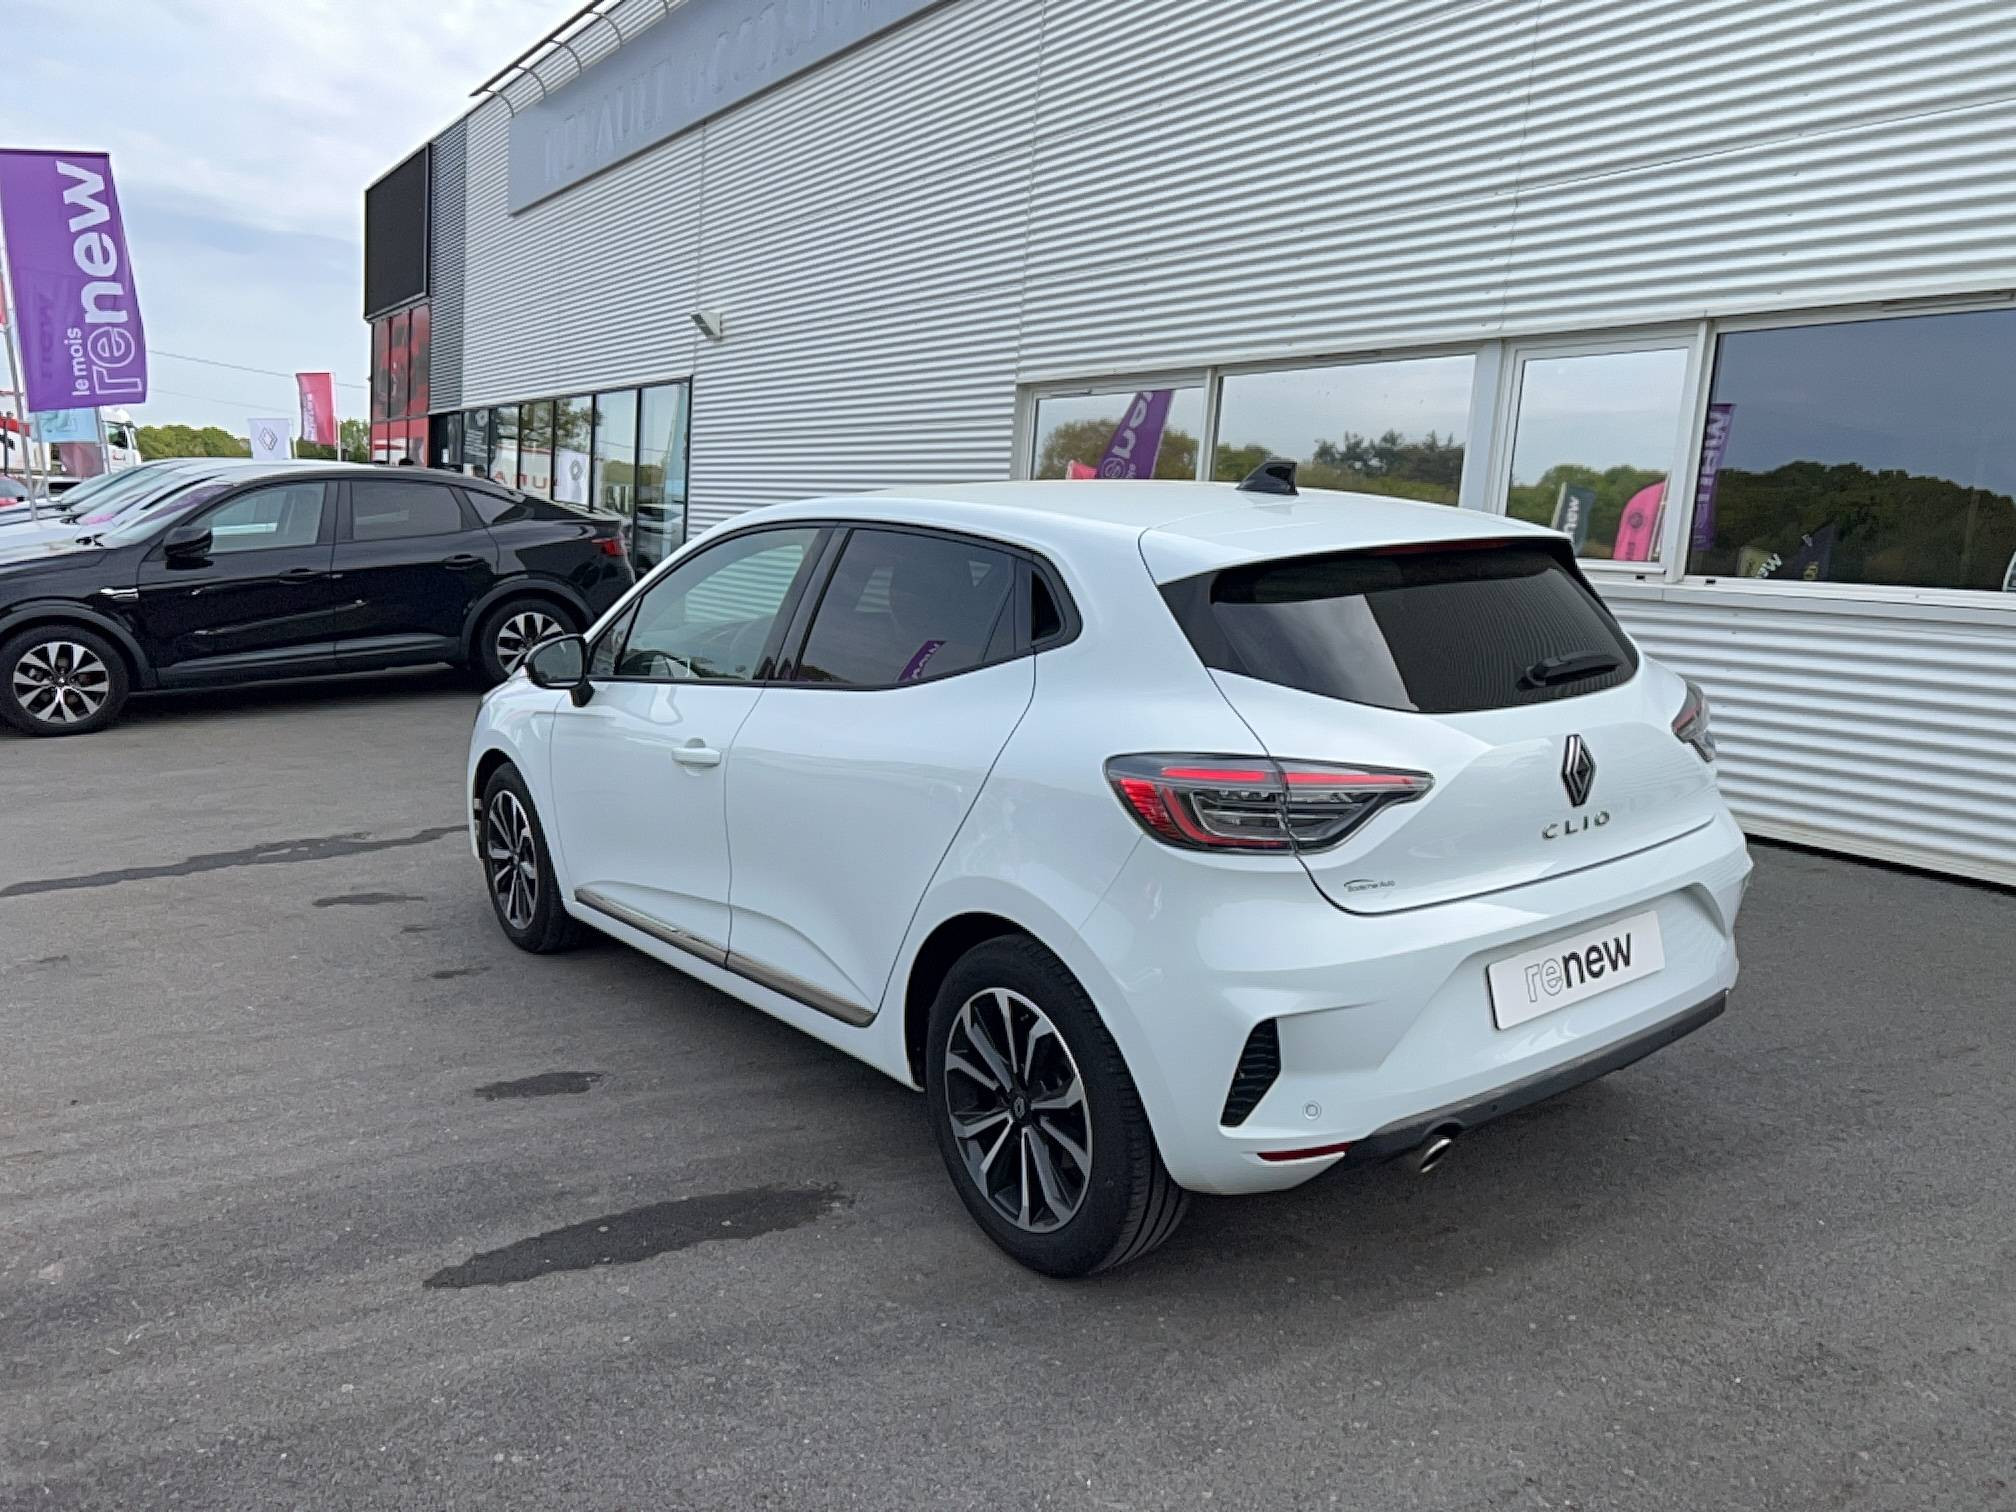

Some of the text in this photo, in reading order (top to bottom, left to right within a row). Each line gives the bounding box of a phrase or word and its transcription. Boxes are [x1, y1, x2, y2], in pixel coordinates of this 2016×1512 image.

[56, 160, 143, 394] renew
[64, 327, 91, 396] le mois
[1542, 811, 1610, 839] CLIO
[1524, 933, 1631, 1003] renew
